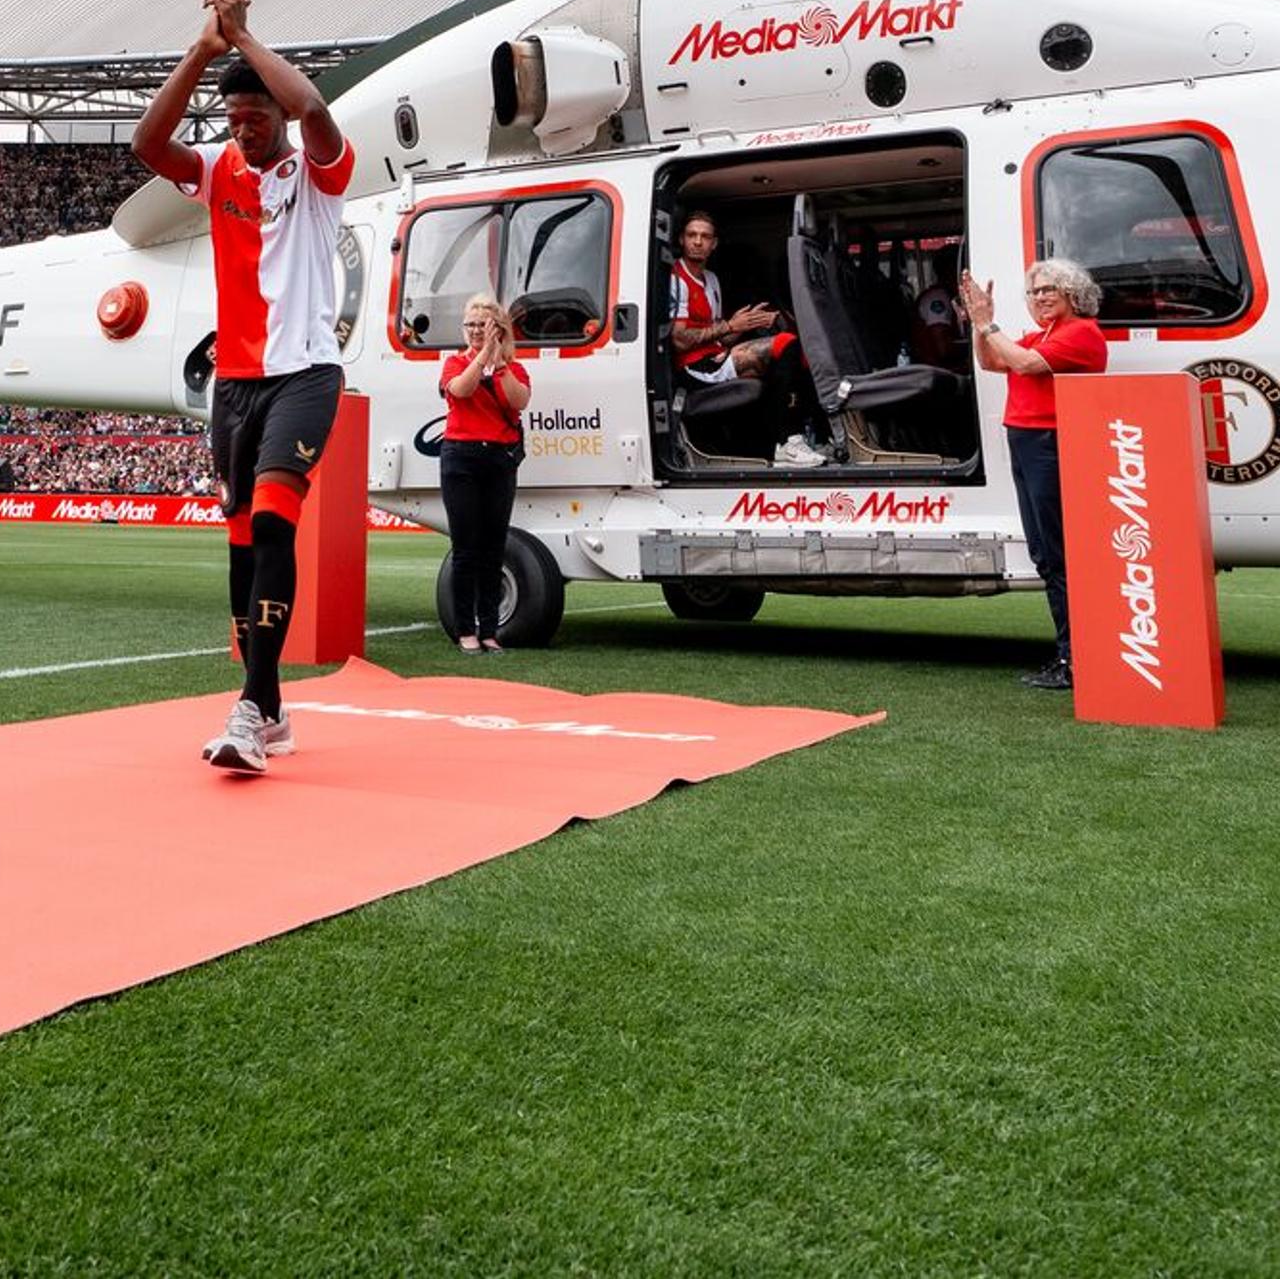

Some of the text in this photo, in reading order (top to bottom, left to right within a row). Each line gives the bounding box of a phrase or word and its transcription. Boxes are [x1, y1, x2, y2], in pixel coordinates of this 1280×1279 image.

[668, 18, 800, 65] Media
[529, 408, 601, 430] Holland
[531, 435, 605, 457] SHORE
[51, 500, 158, 521] Media Markt
[725, 491, 949, 523] Media Markt
[1107, 418, 1164, 692] Media Markt
[257, 600, 288, 628] F
